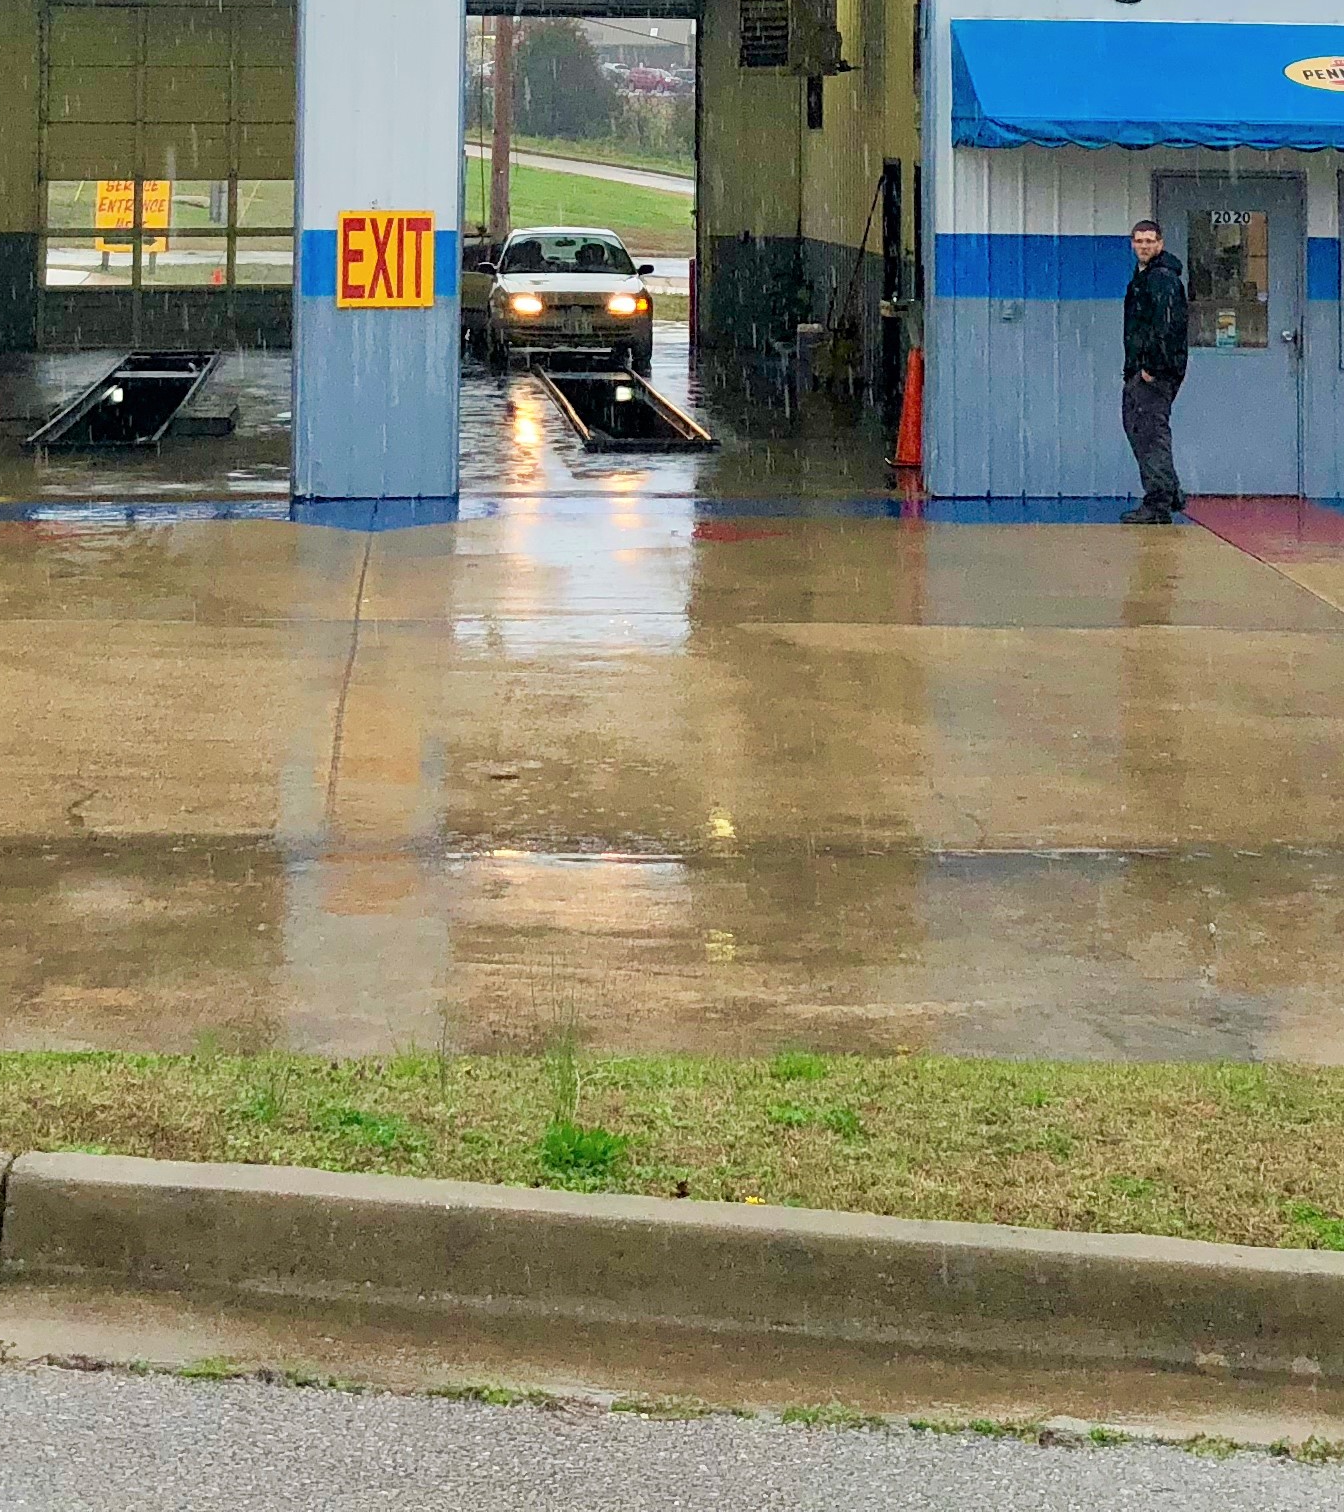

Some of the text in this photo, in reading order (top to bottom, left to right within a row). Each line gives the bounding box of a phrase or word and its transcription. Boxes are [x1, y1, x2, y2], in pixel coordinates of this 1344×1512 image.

[106, 181, 159, 192] SERCE
[98, 196, 166, 213] ENTRNCE
[1214, 211, 1251, 224] 2020
[341, 217, 432, 299] EXIT
